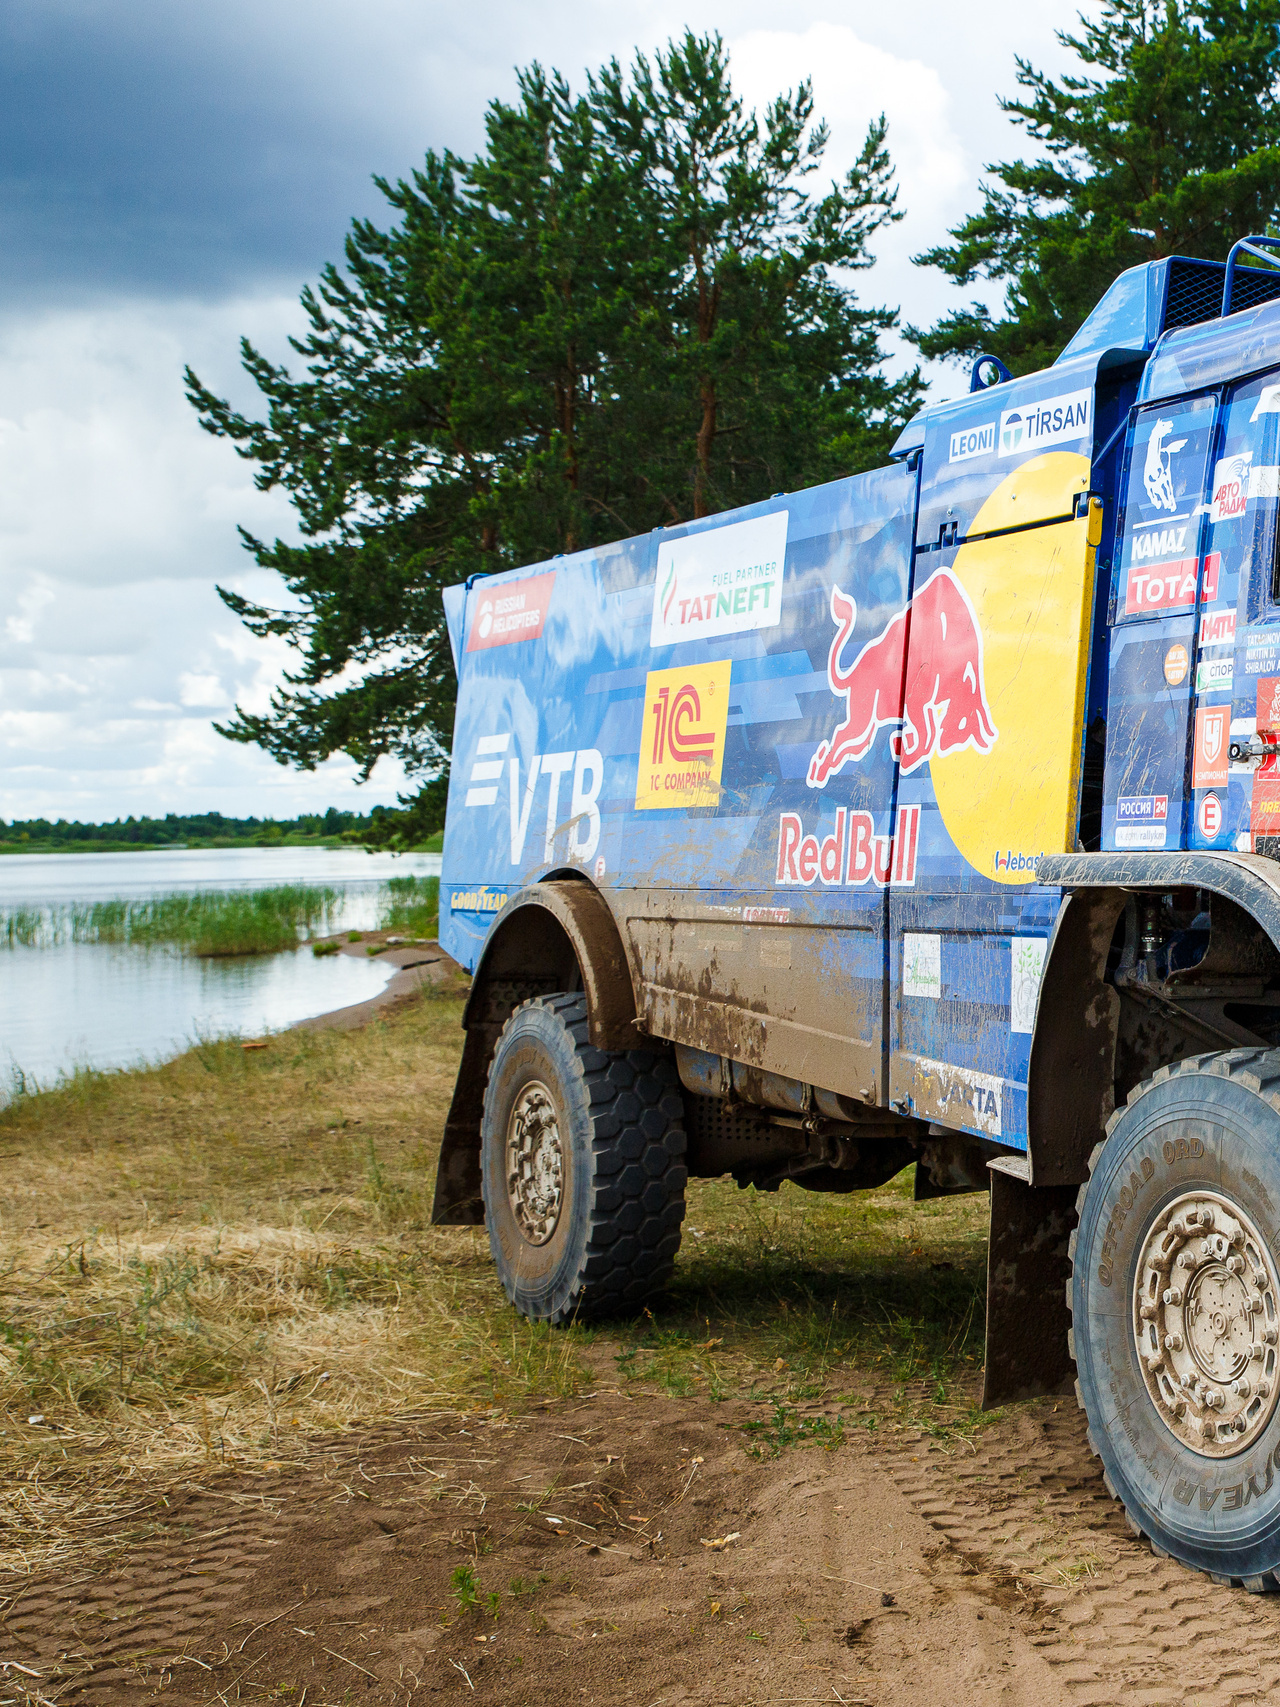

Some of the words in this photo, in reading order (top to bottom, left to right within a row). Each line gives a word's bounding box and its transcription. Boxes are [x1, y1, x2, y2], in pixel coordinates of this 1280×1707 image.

[952, 425, 992, 458] LEONI
[1214, 481, 1240, 503] АВТО
[1131, 526, 1188, 561] KAMAZ
[712, 572, 734, 586] FUEL
[736, 561, 777, 583] PARTNER
[1131, 570, 1215, 605] TOTAL
[494, 593, 526, 615] RUSSIAN
[679, 580, 776, 625] TATNEFT
[492, 608, 541, 634] HELICOPTERS
[665, 771, 712, 790] COMPANY
[510, 749, 604, 865] VTB
[1120, 801, 1152, 815] РОССИЯ
[1155, 801, 1166, 814] 24
[1204, 804, 1216, 830] E
[995, 850, 1043, 871] Webas
[1098, 1156, 1155, 1288] OFFROAD
